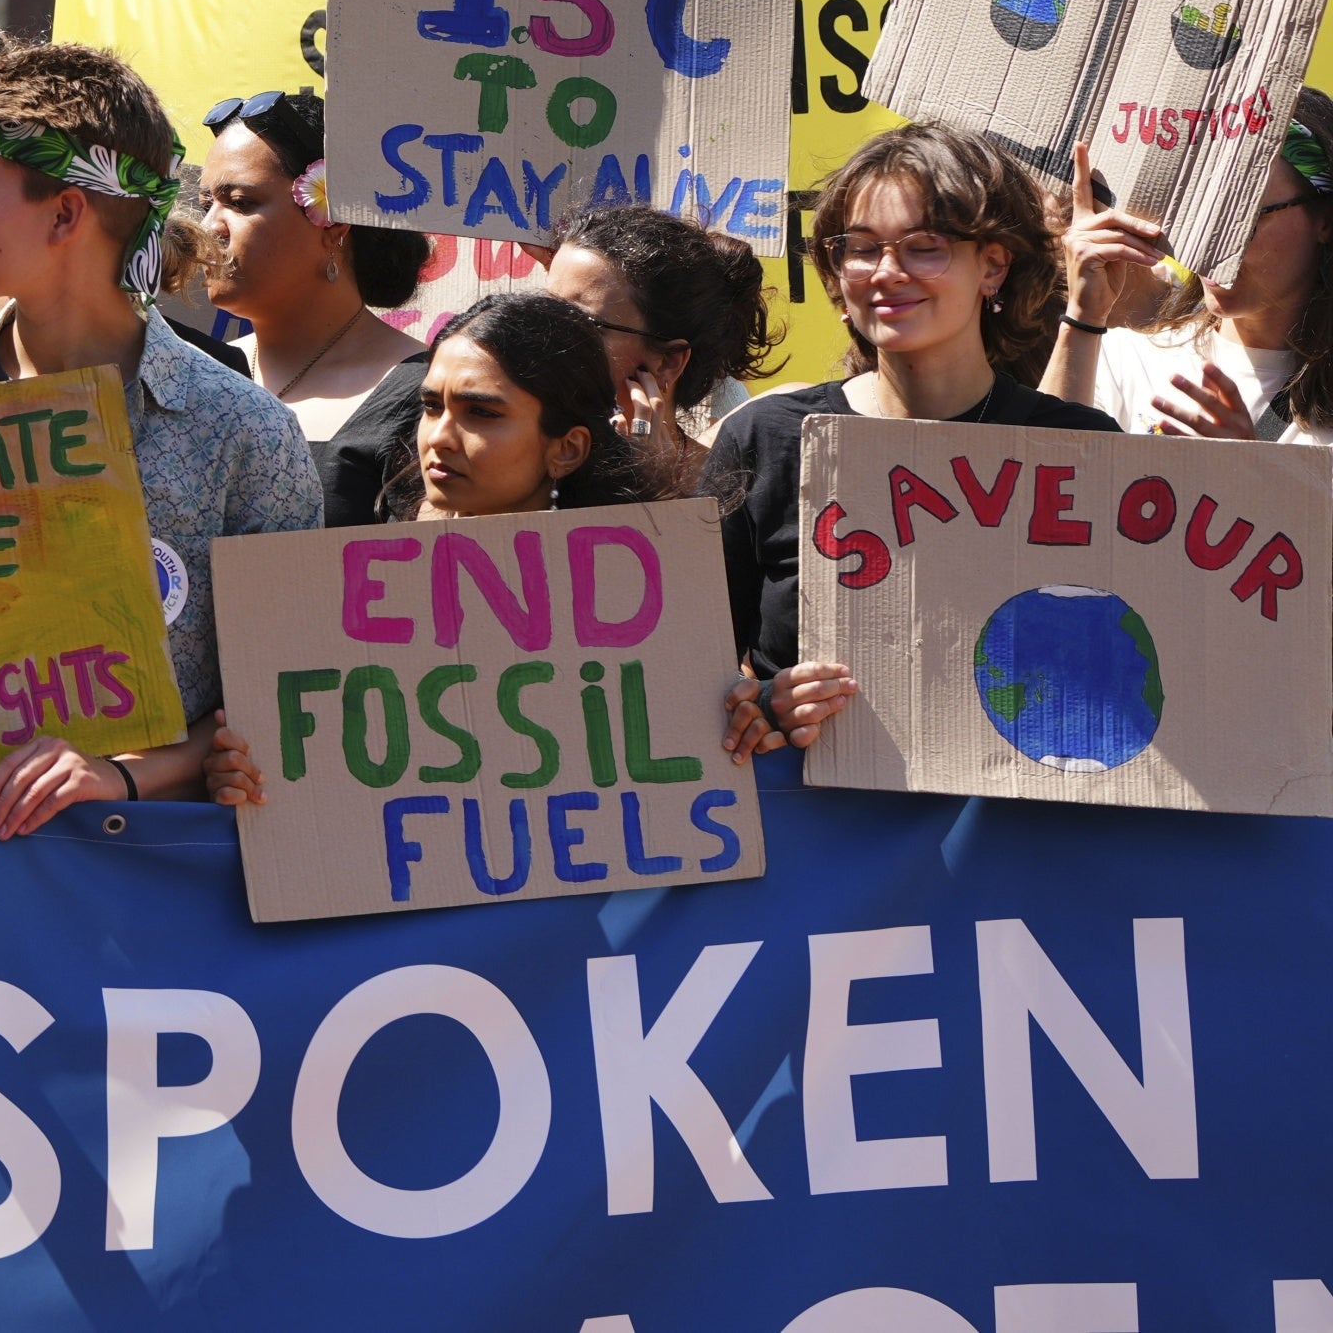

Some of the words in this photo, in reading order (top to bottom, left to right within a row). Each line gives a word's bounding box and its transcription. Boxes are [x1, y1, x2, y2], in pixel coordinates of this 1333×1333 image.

[454, 53, 617, 149] TO
[1112, 86, 1276, 151] JUSTICE!
[374, 123, 566, 231] STAY
[153, 547, 177, 575] OUTH
[341, 525, 663, 652] END
[813, 455, 1093, 590] SAVE
[1117, 475, 1304, 622] OUR
[383, 788, 740, 902] FUELS
